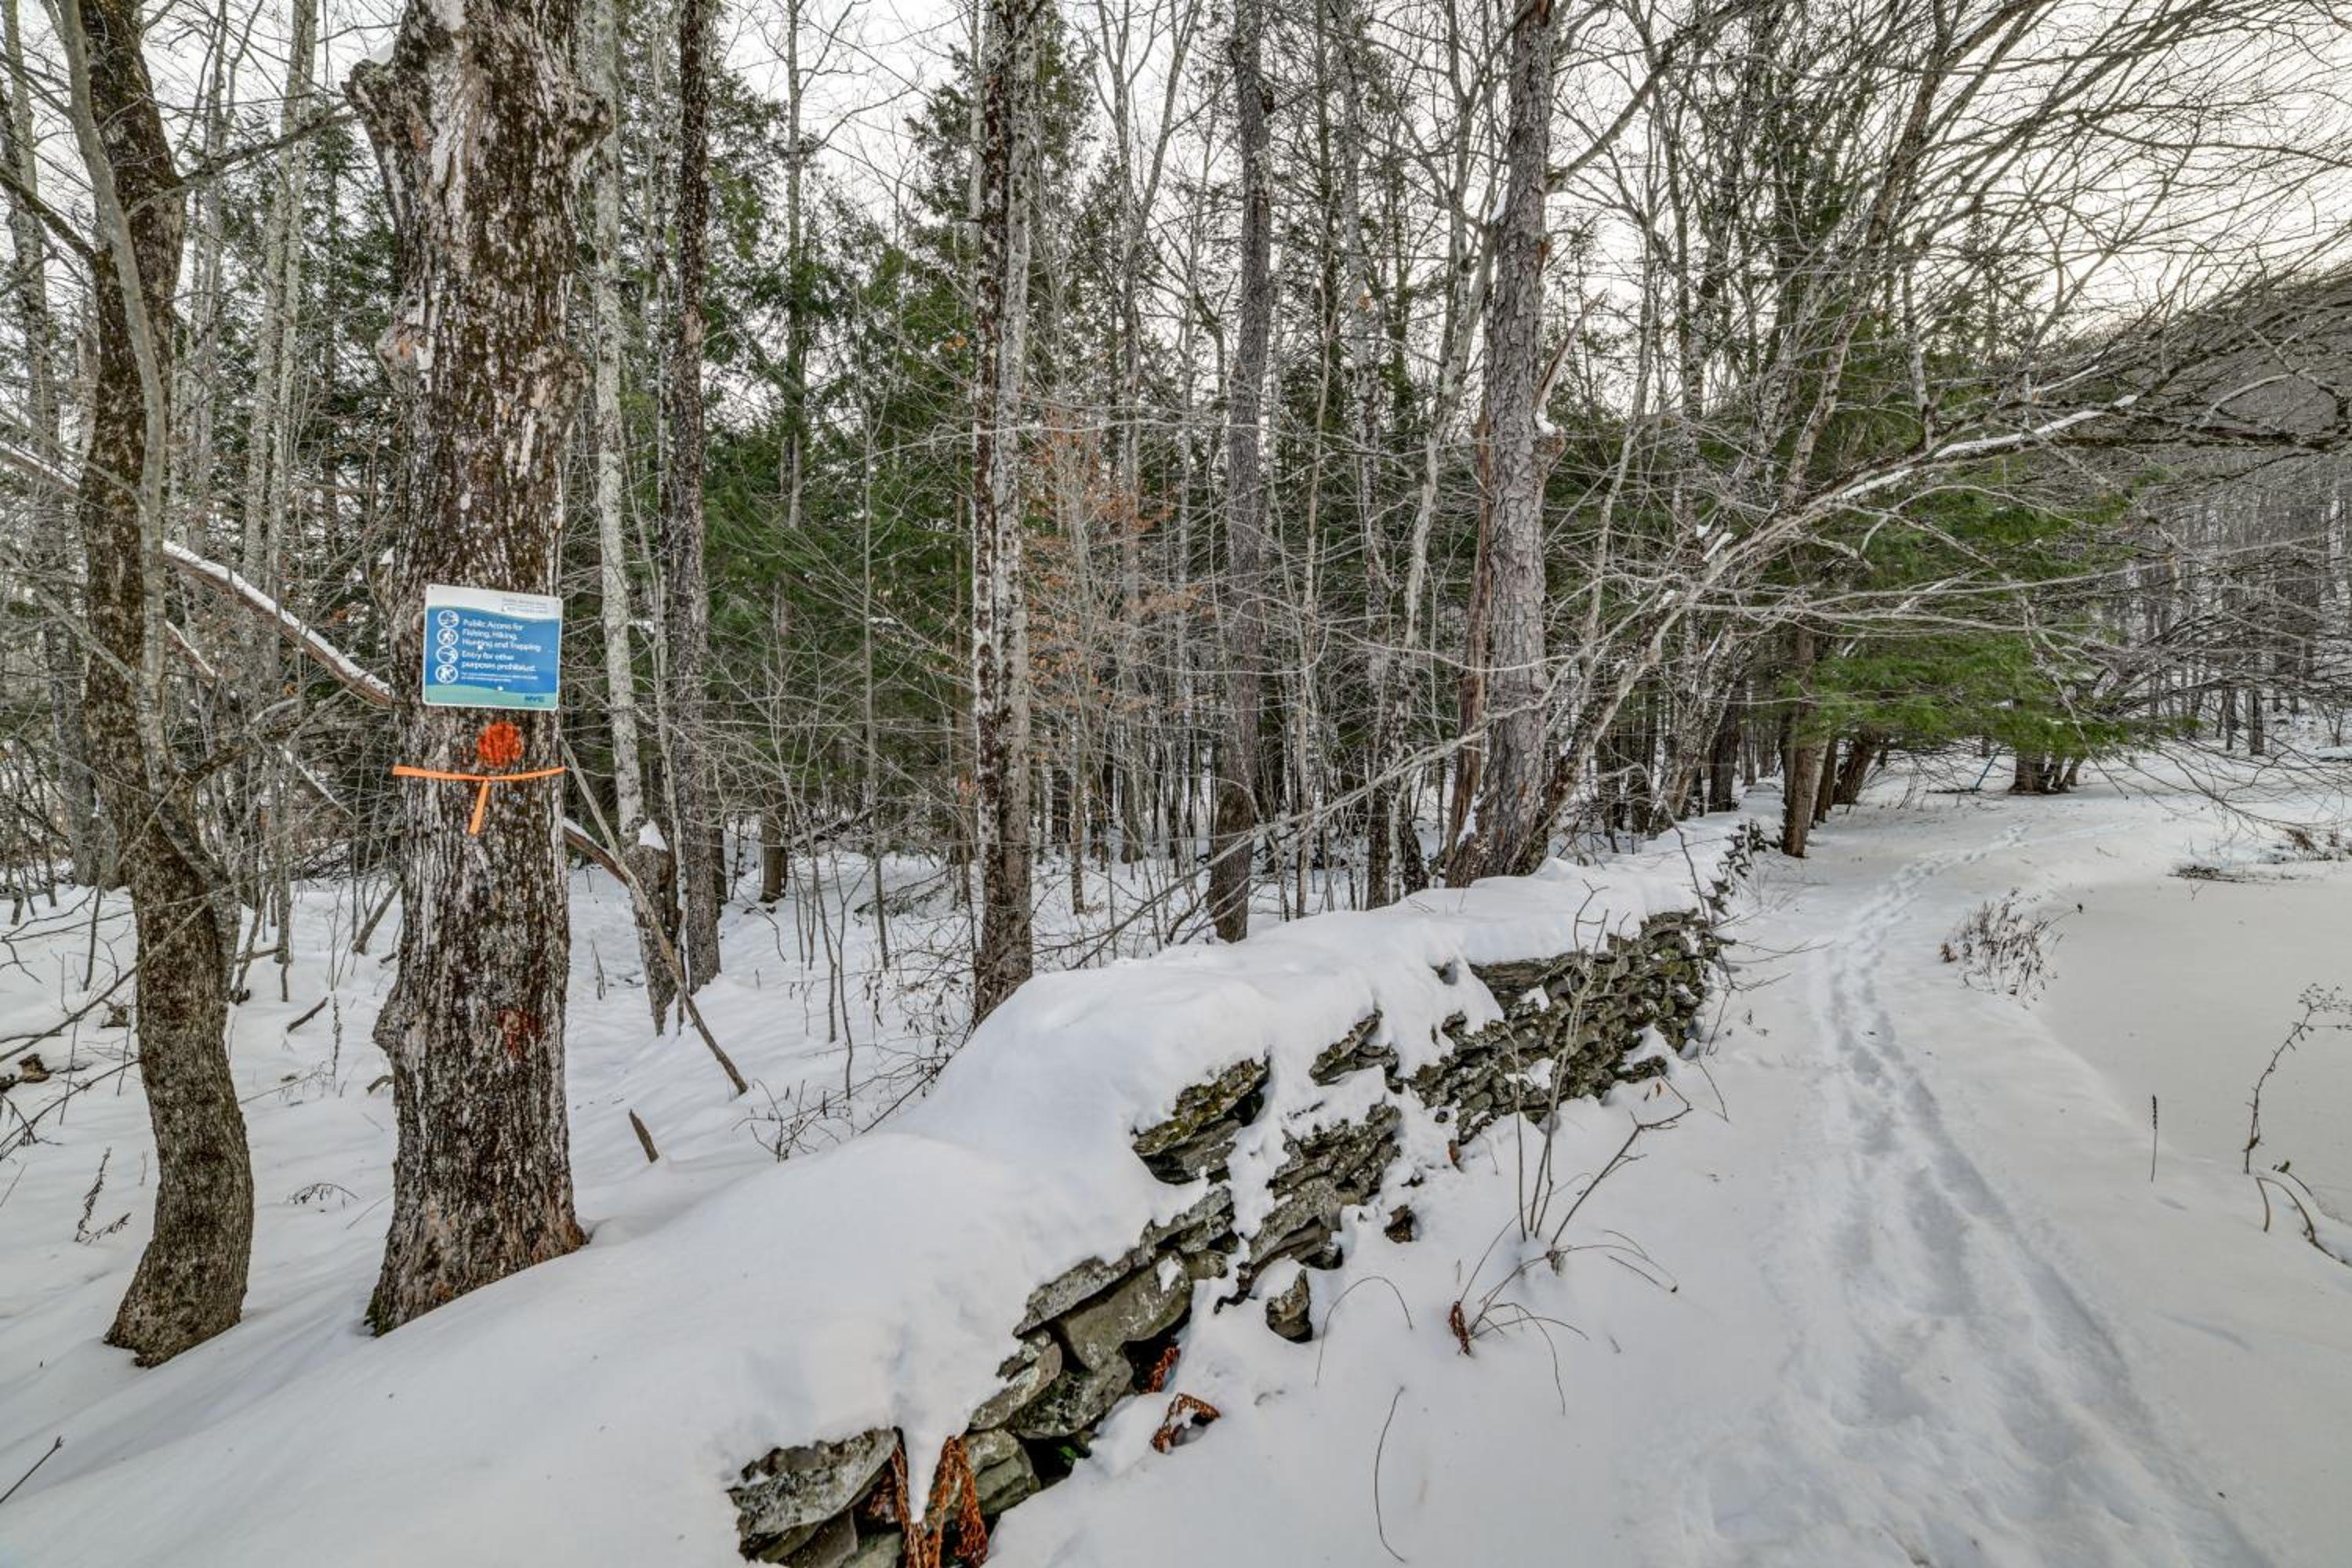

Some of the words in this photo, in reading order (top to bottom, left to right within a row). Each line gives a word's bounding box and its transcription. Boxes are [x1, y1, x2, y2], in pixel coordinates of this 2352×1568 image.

[463, 619, 485, 628] Public
[487, 621, 511, 630] Access
[463, 638, 493, 648] Hunting
[462, 650, 482, 660] Entry
[461, 662, 496, 670] purposes
